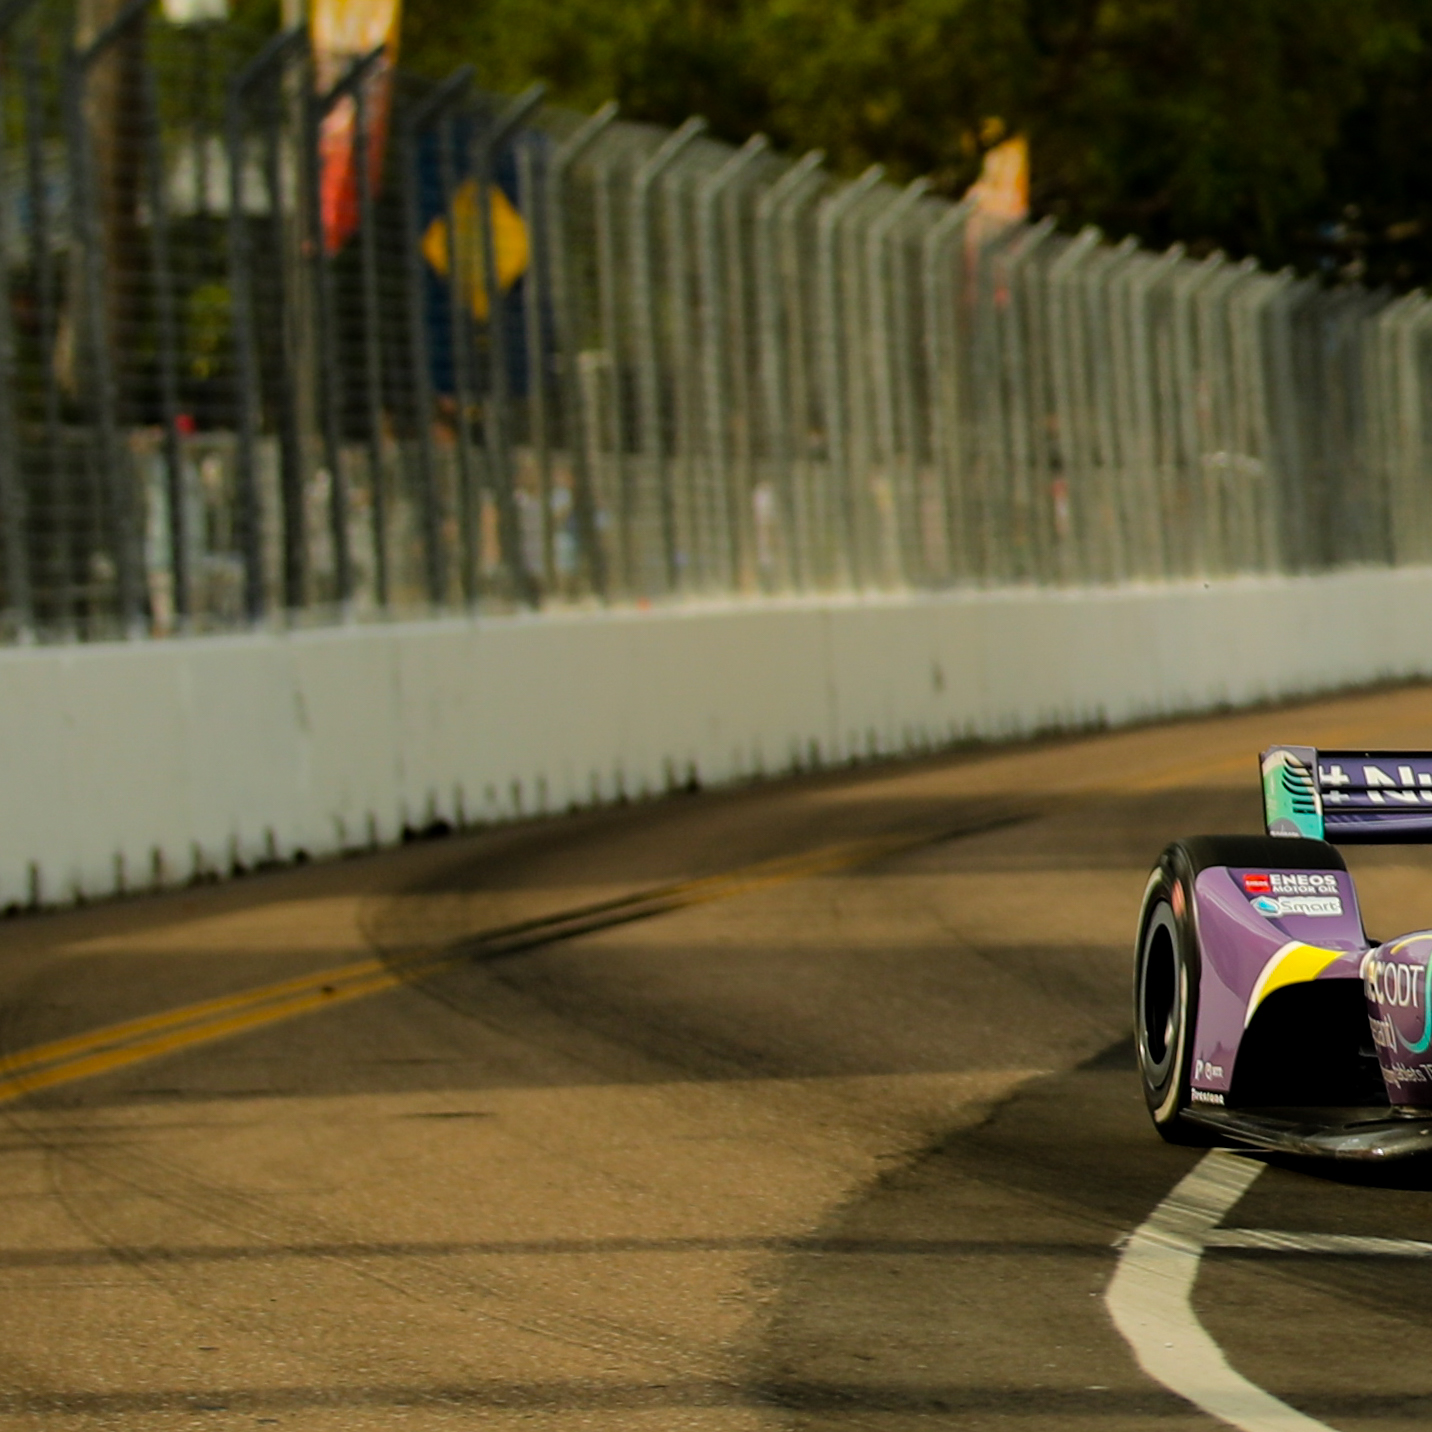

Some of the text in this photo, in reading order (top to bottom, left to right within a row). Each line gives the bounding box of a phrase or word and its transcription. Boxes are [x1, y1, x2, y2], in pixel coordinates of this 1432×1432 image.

[1269, 874, 1337, 886] ENEOS
[1272, 885, 1339, 894] MOTOR OIL
[1280, 901, 1338, 912] Smart
